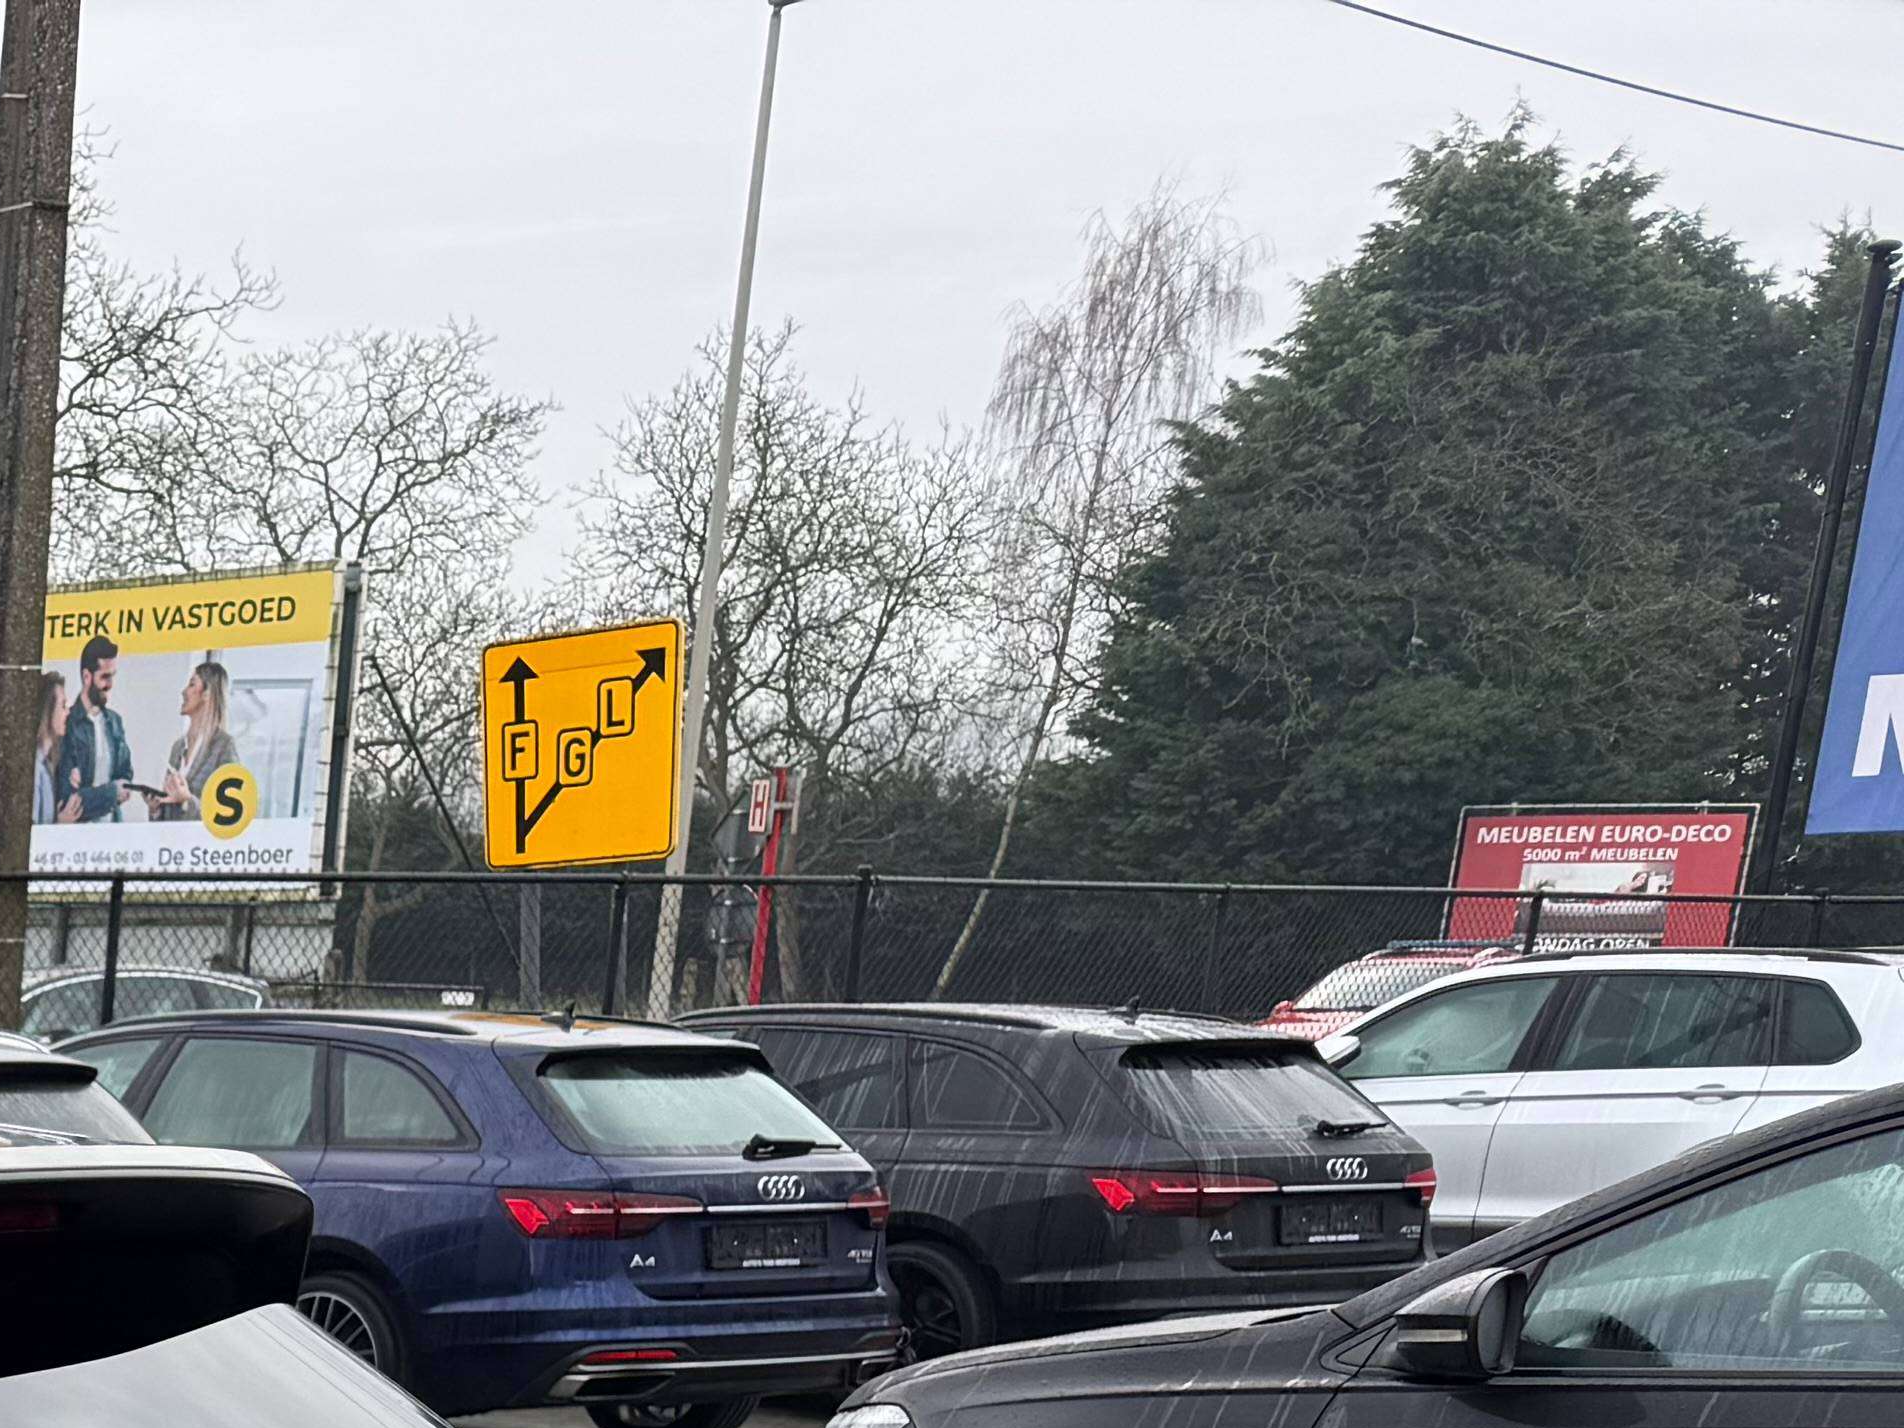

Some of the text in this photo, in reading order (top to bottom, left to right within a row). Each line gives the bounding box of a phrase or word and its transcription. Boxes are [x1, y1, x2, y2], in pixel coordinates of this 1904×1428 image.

[47, 596, 296, 638] TERK IN VASTGOED
[606, 688, 625, 728] L
[510, 731, 530, 770] F
[564, 737, 586, 778] G
[213, 777, 244, 826] S
[1477, 824, 1732, 844] MEUBELEN EURO-DECO
[158, 844, 293, 867] De Steenboer
[1523, 848, 1562, 861] 5000
[1590, 848, 1678, 861] MEUBELEN
[1210, 1229, 1233, 1242] A4
[630, 1254, 655, 1268] A4
